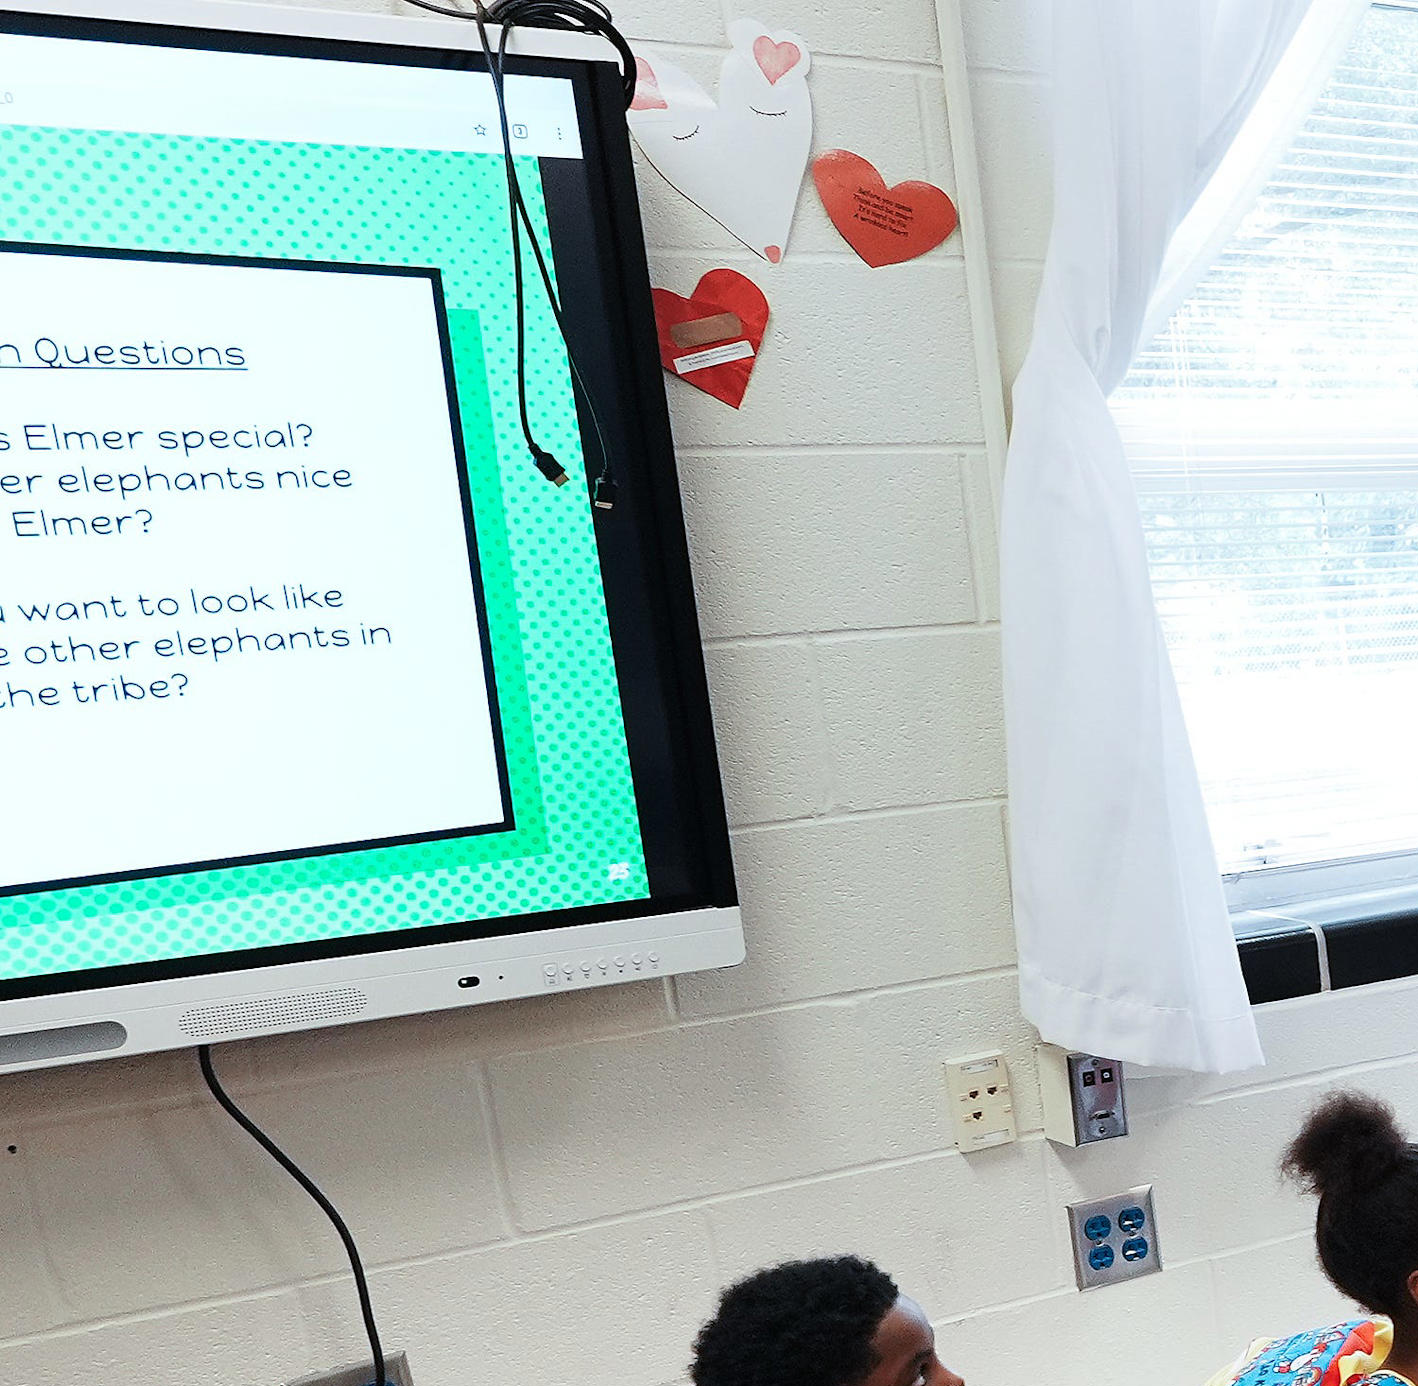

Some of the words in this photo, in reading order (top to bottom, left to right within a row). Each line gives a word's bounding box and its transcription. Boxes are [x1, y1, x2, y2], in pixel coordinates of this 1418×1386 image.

[34, 337, 246, 368] Questions
[23, 423, 144, 451] Elmer
[157, 421, 313, 456] special?
[58, 465, 265, 500] elephants
[276, 465, 353, 489] nice
[11, 508, 153, 537] Elmer?
[17, 595, 127, 621] want
[138, 593, 179, 616] to
[190, 586, 275, 614] look
[283, 583, 343, 610] like
[24, 636, 141, 665] other
[154, 626, 350, 662] elephants
[360, 622, 392, 645] in
[72, 673, 188, 704] tribe?
